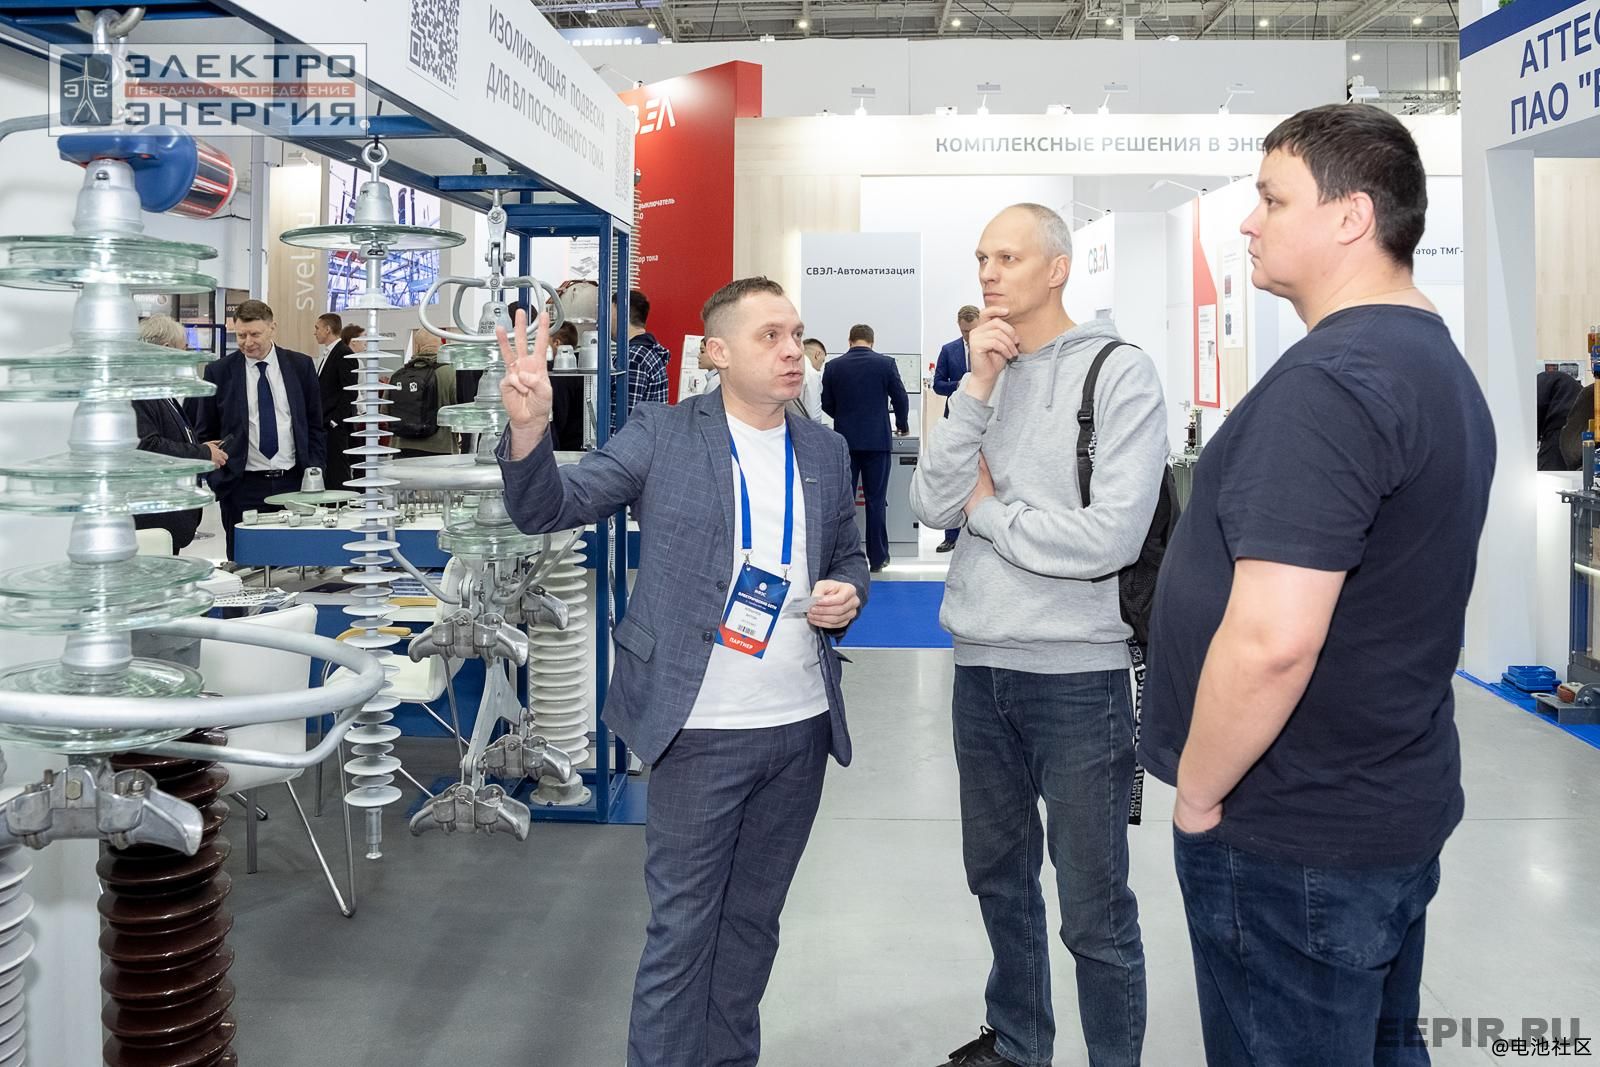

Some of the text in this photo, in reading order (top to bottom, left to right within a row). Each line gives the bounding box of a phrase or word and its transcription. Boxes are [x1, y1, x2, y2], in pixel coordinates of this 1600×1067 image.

[489, 4, 605, 135] ИЗОЛИРУЮЩАЯ ПОДВЕСКА
[1511, 81, 1569, 135] ПАО
[486, 62, 605, 172] ДЛЯ ВЛ ПОСТОЯННОГО ТОКА
[935, 136, 1264, 153] КОМПЛЕКСНЫЕ РЕШЕНИЯ В ЭНЕ
[1415, 247, 1438, 257] атор
[805, 266, 915, 277] СВЭЛ-Автоматизация
[729, 637, 753, 649] ПАРТНЕР
